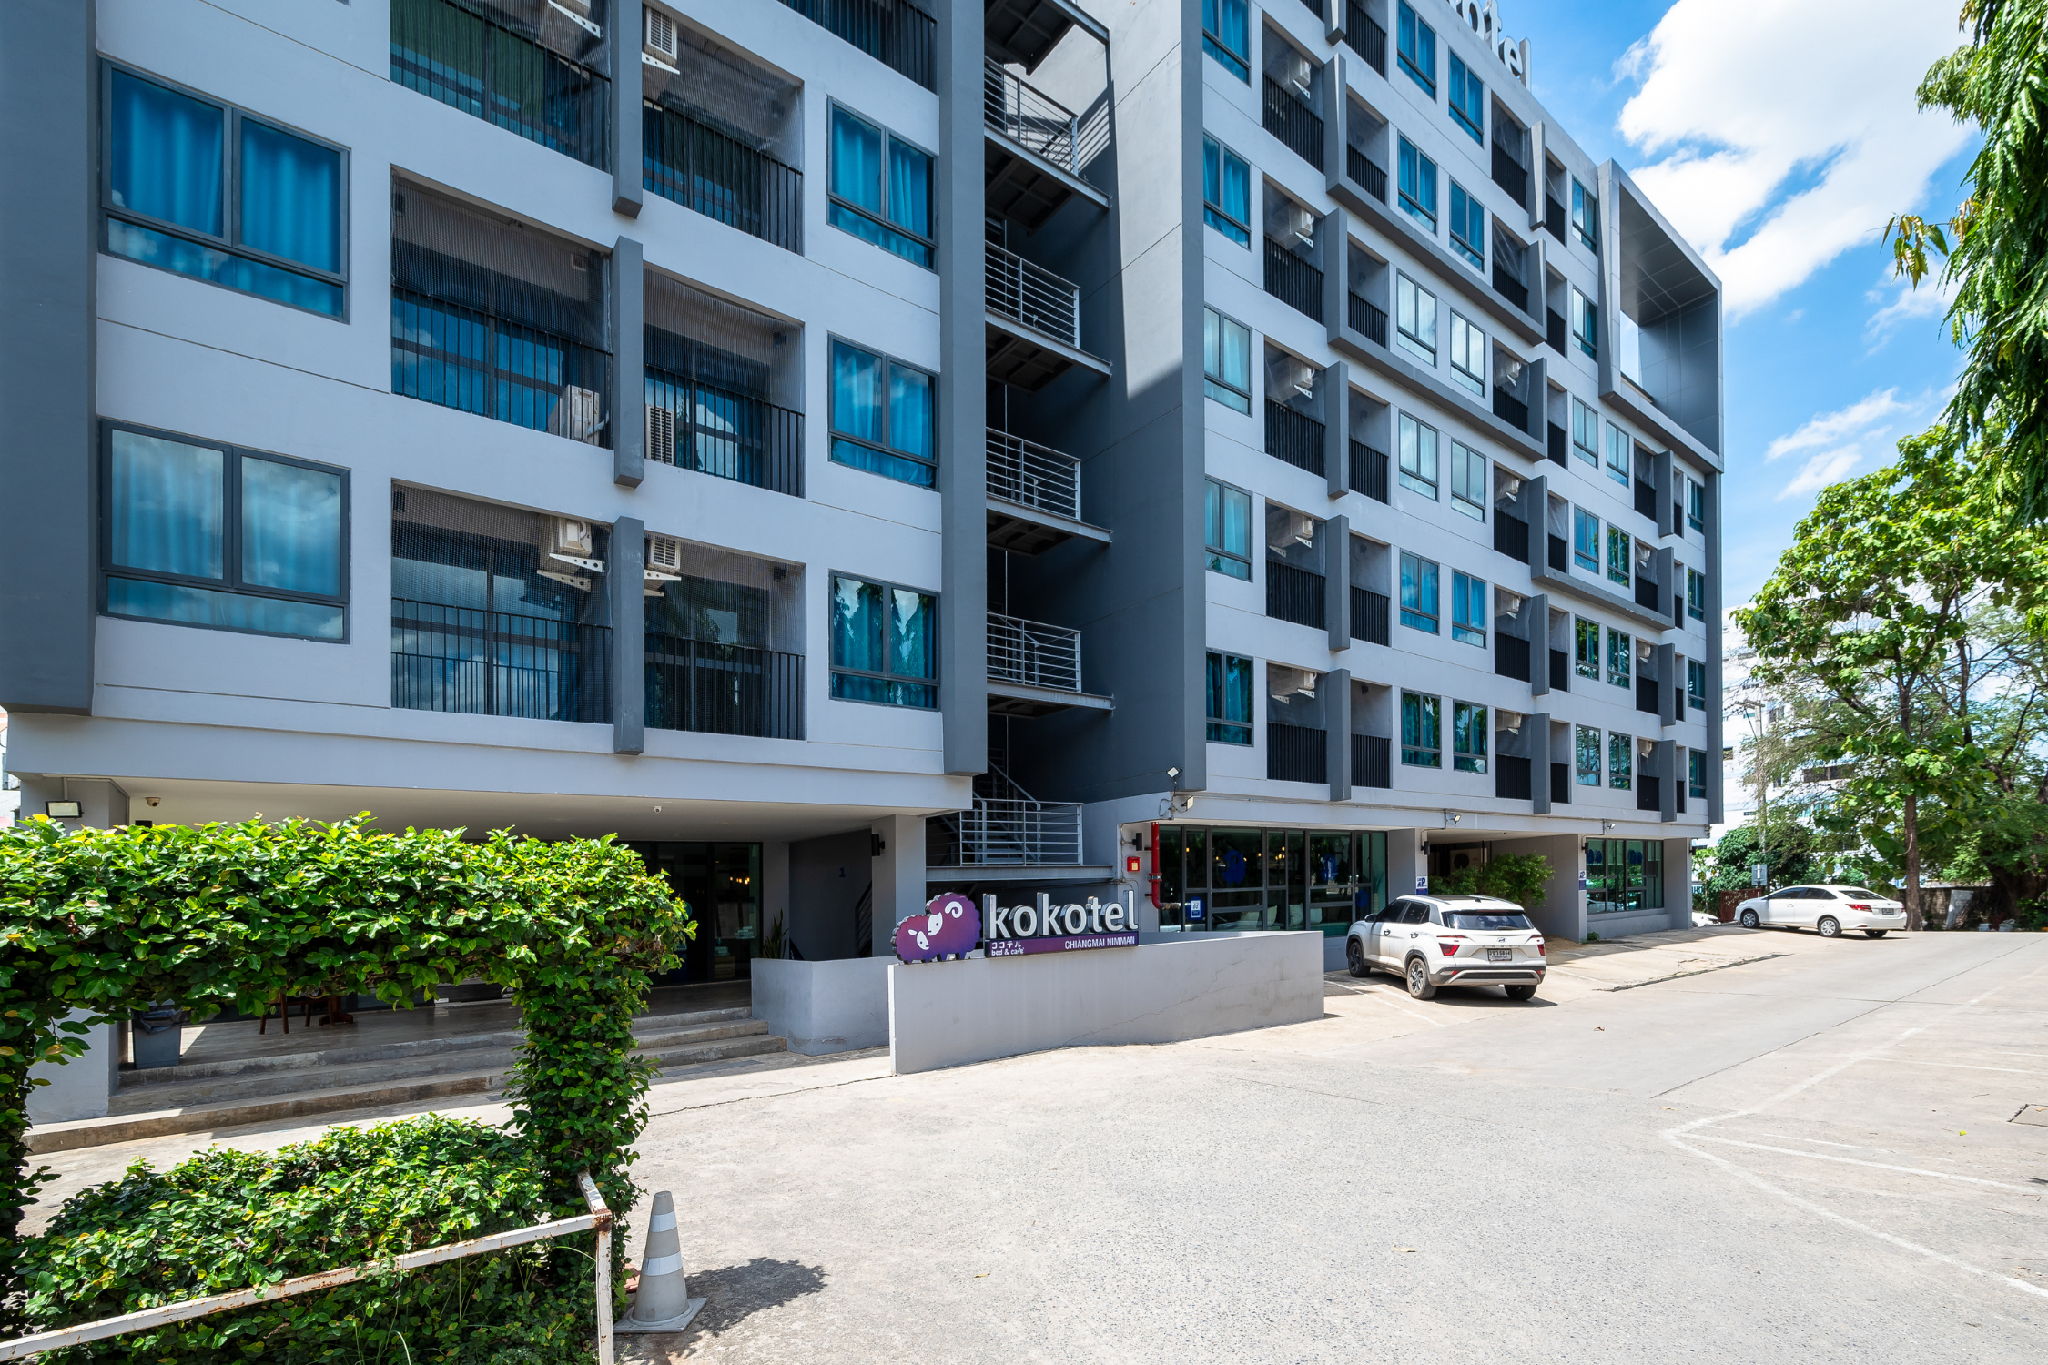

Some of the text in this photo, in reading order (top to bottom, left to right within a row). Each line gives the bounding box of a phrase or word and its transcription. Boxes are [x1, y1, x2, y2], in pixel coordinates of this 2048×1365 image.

[1449, 0, 1532, 92] otel
[986, 889, 1139, 939] kokotel
[1004, 948, 1010, 956] &
[1064, 935, 1135, 950] CHIANGMAI NIMMAN
